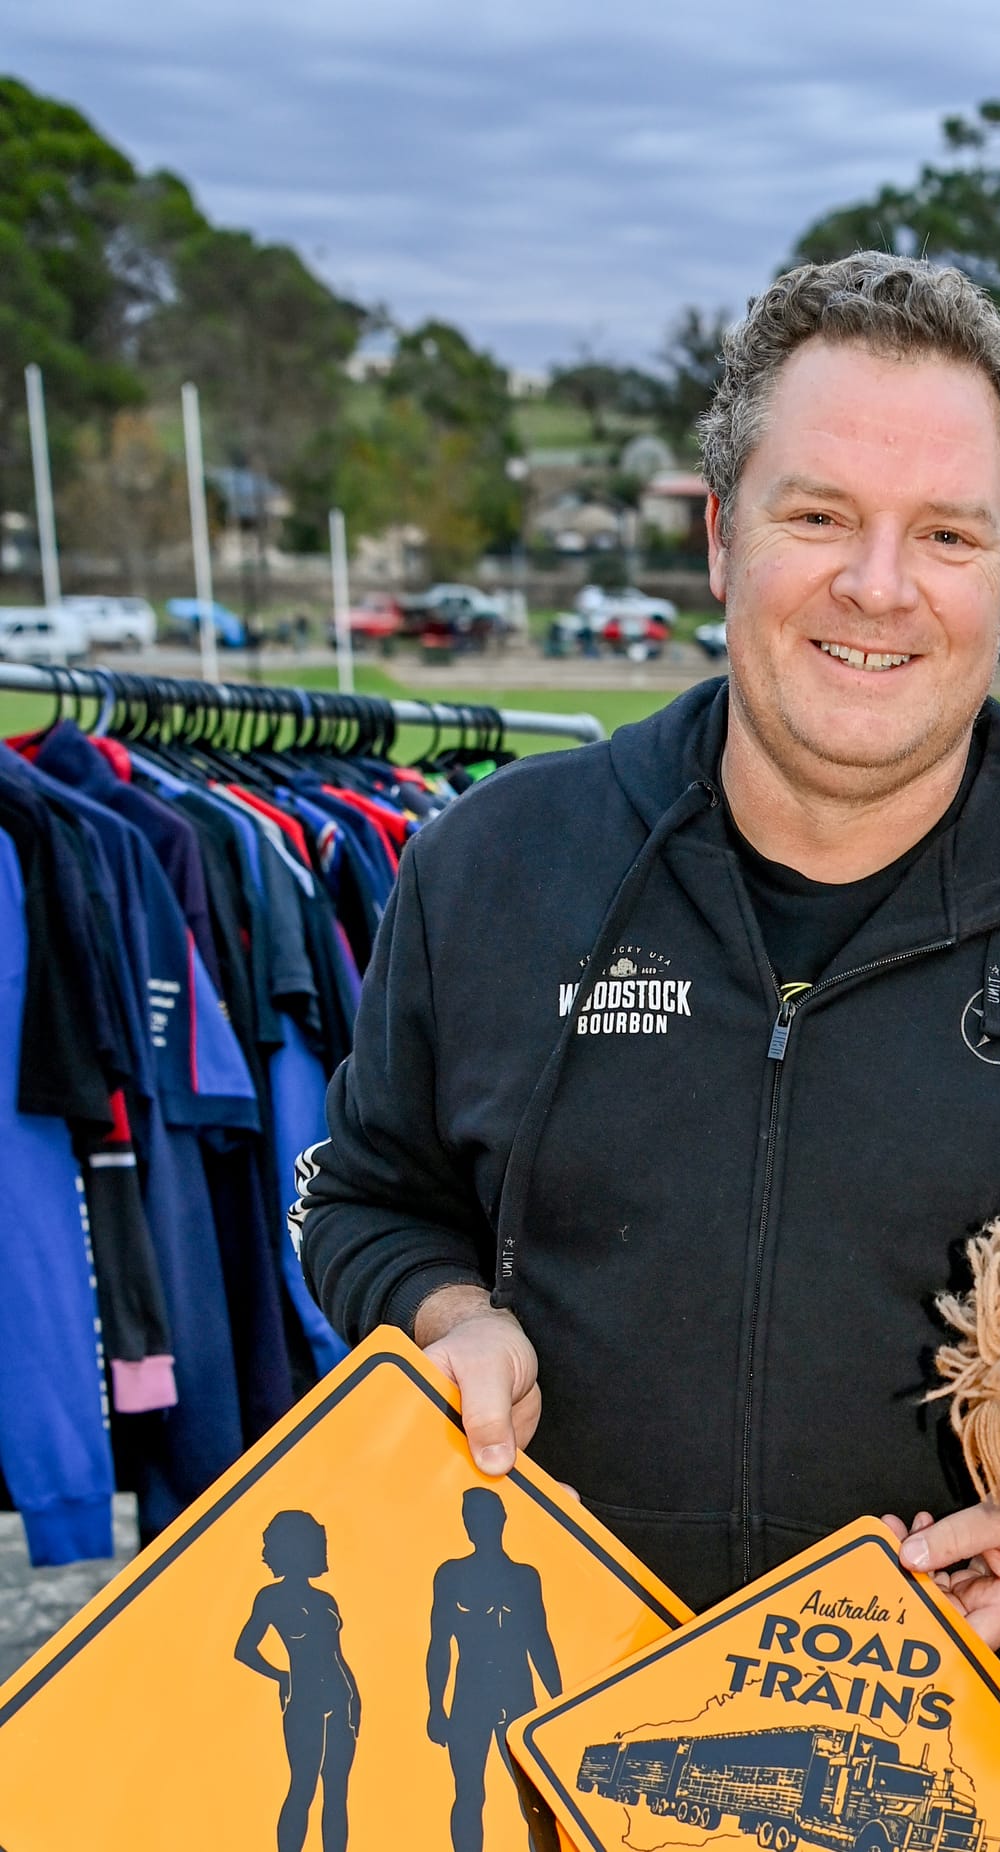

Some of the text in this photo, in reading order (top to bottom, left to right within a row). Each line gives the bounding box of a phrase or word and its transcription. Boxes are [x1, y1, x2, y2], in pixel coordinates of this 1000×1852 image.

[649, 952, 671, 966] USA
[987, 976, 1000, 1003] UNIT
[577, 1012, 668, 1034] BOURBON
[502, 1250, 514, 1278] UNIT
[800, 1590, 906, 1624] Australia's
[758, 1614, 941, 1678] ROAD
[725, 1654, 955, 1730] TRAINS
